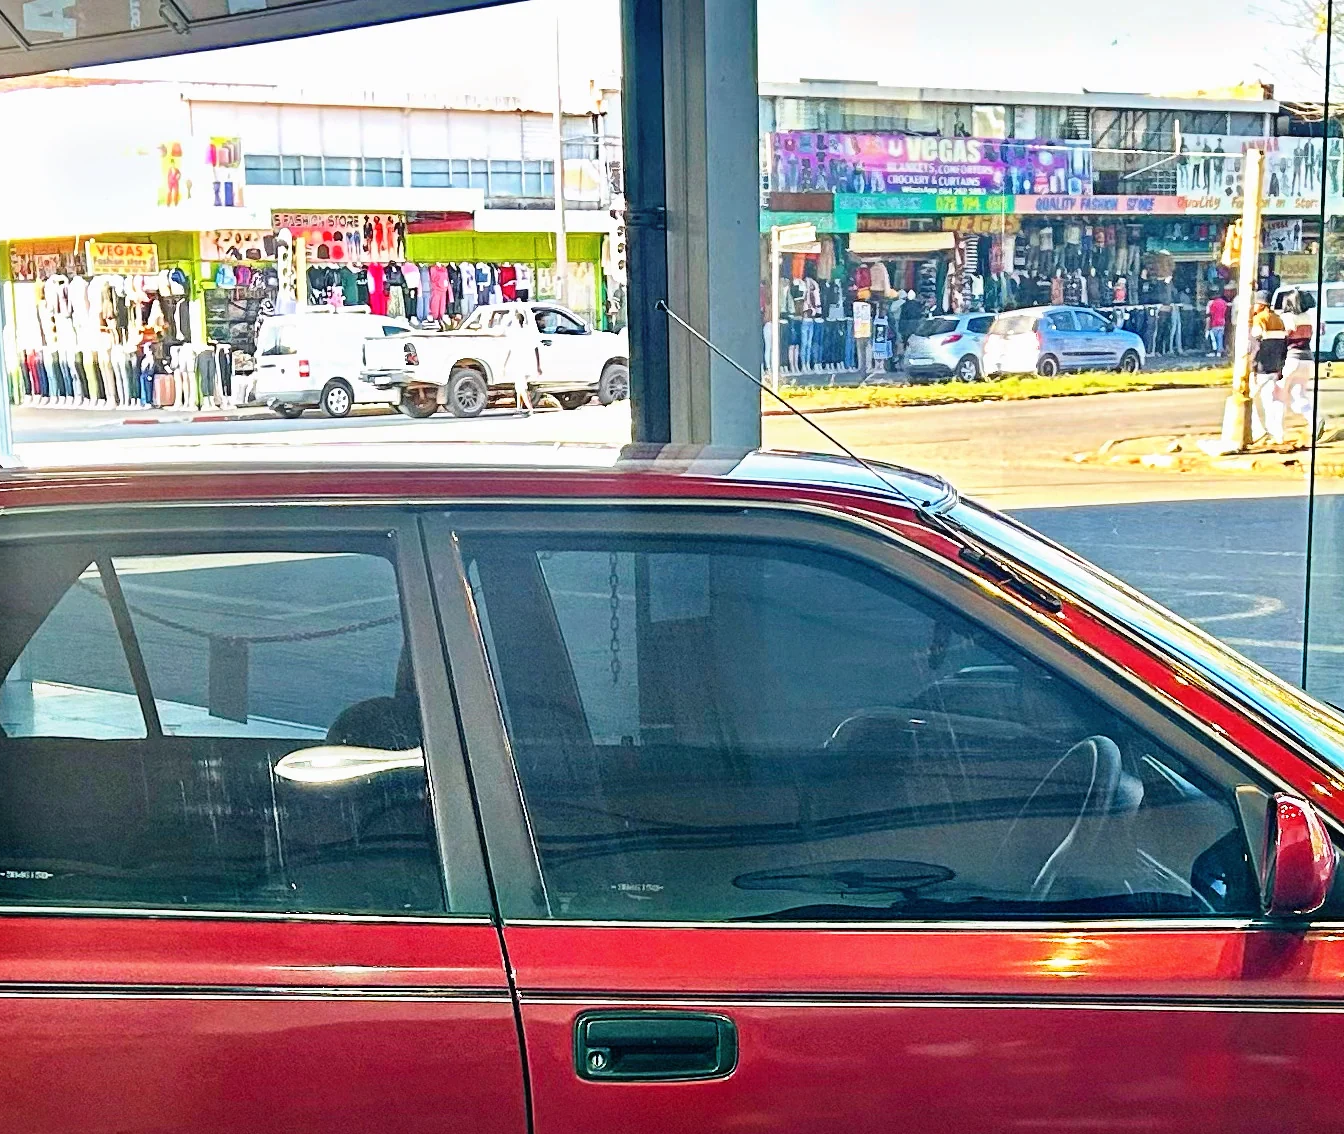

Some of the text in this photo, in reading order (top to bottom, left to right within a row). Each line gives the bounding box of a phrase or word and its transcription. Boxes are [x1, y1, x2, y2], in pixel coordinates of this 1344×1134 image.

[887, 175, 929, 184] CROCKERY
[938, 177, 980, 186] CURTAINS
[328, 215, 359, 227] STORE
[96, 245, 143, 256] VEGAS
